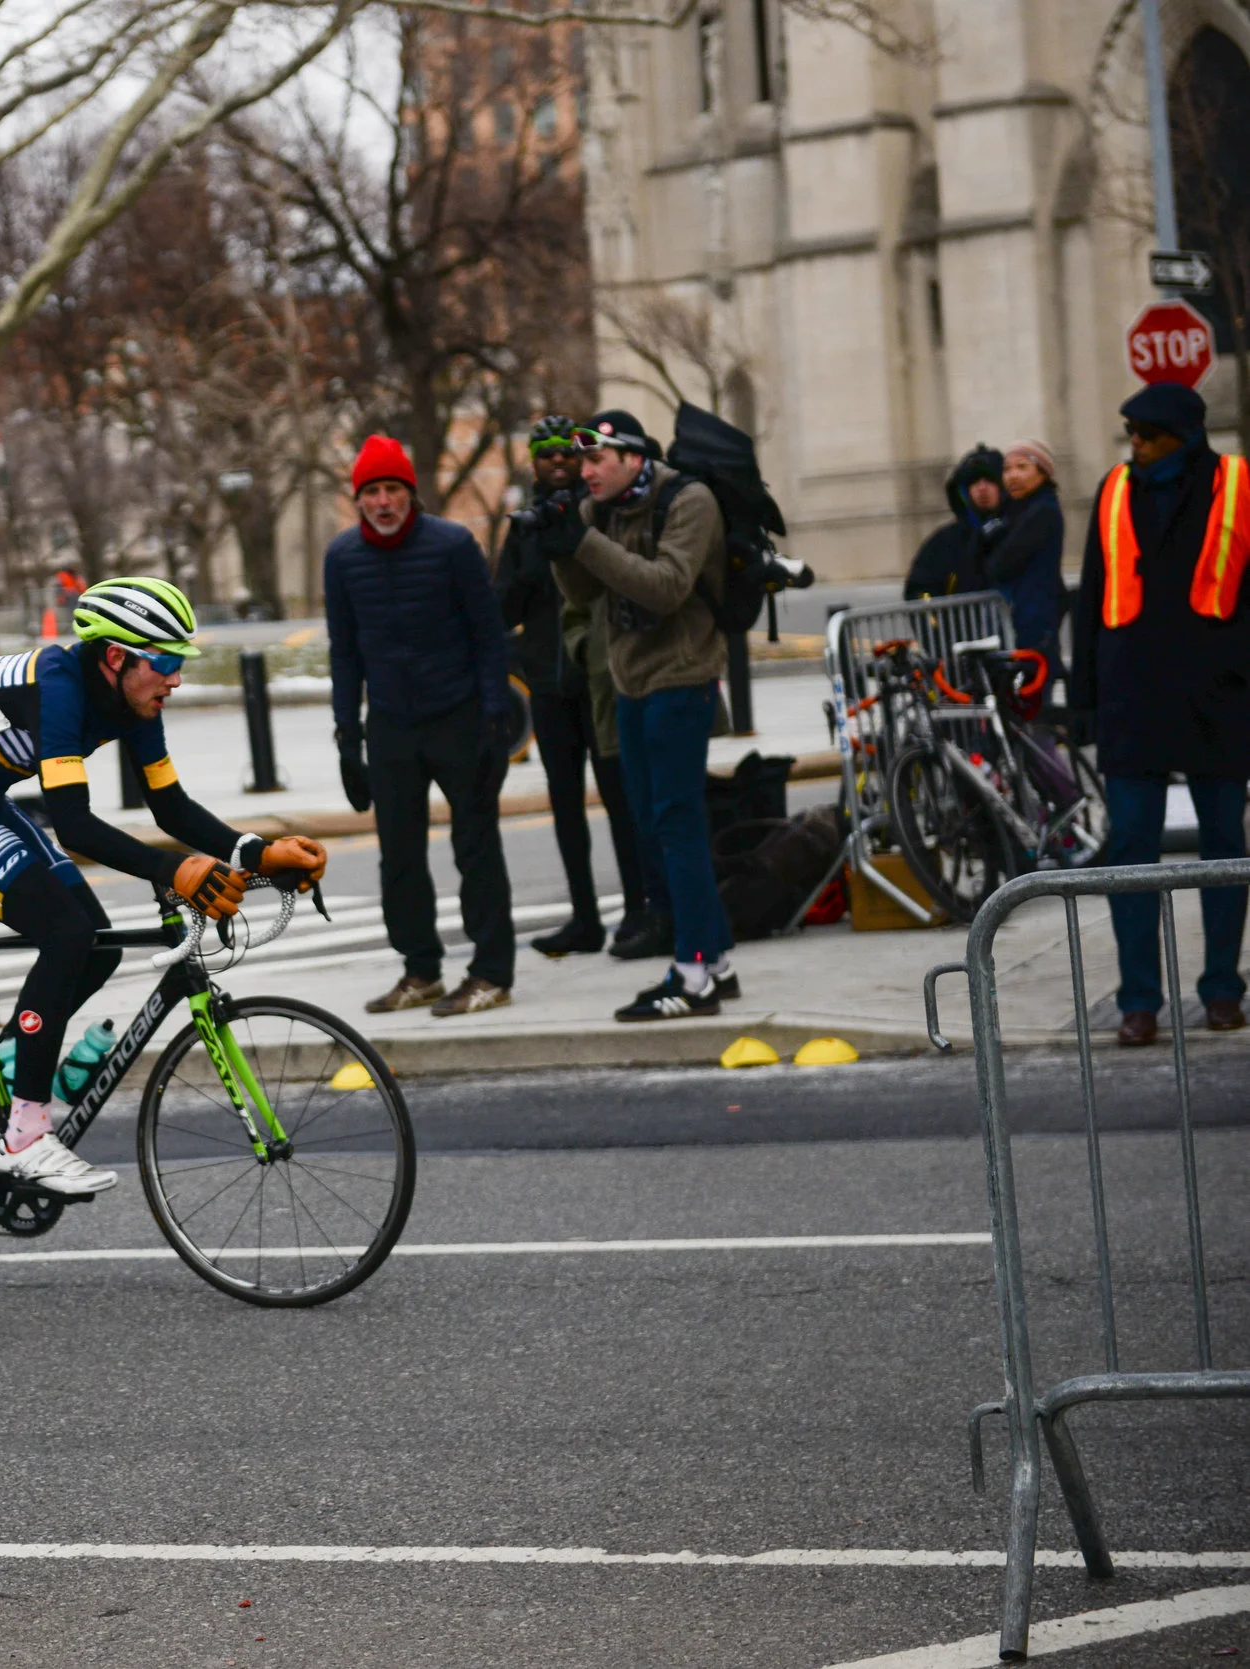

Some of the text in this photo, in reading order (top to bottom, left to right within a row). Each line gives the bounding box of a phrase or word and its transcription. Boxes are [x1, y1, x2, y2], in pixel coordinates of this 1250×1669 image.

[1132, 327, 1206, 371] STOP
[124, 600, 149, 616] GIRO
[58, 991, 166, 1146] annondale
